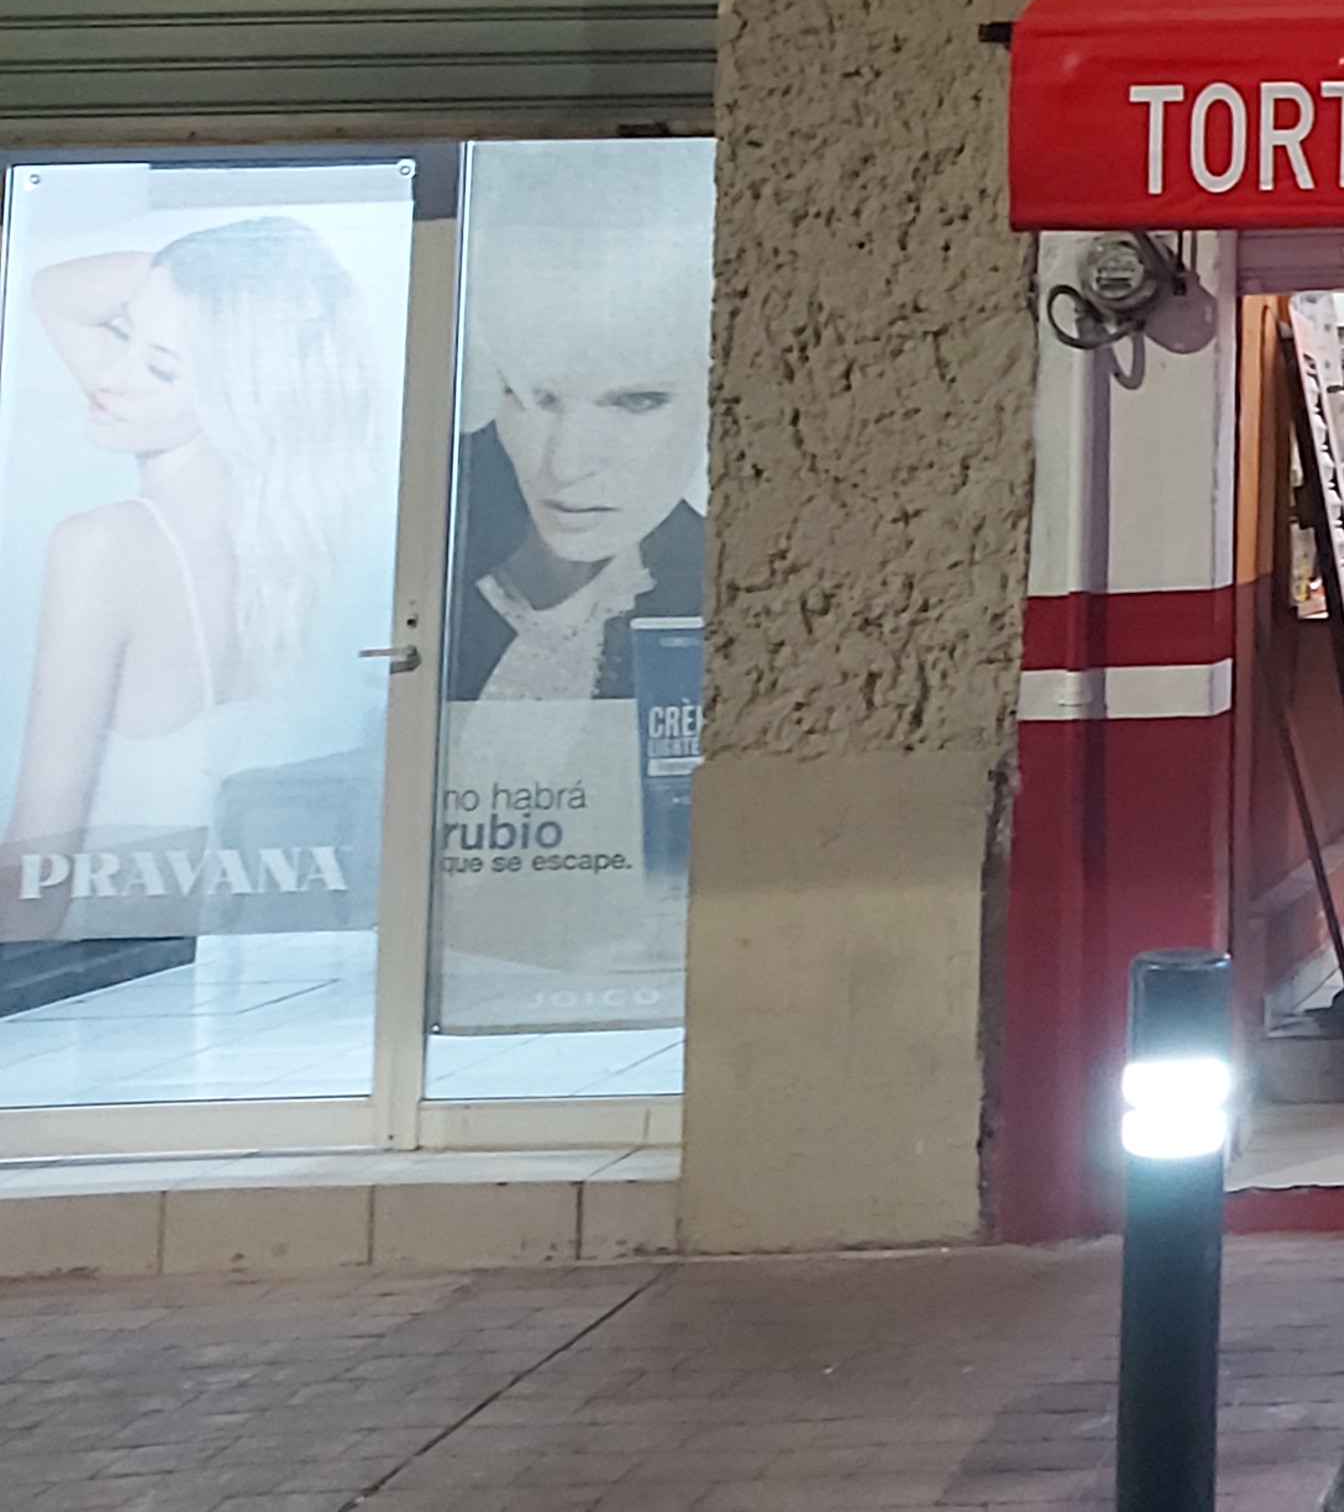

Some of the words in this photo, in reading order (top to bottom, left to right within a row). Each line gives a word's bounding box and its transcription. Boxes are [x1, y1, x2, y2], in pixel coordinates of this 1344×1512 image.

[442, 788, 481, 813] no
[491, 779, 587, 811] habrá
[442, 812, 564, 851] rubio
[18, 845, 350, 901] PRAVANA
[441, 855, 484, 878] que
[491, 855, 523, 873] se
[531, 852, 633, 875] escape.
[528, 989, 661, 1009] JOICO
